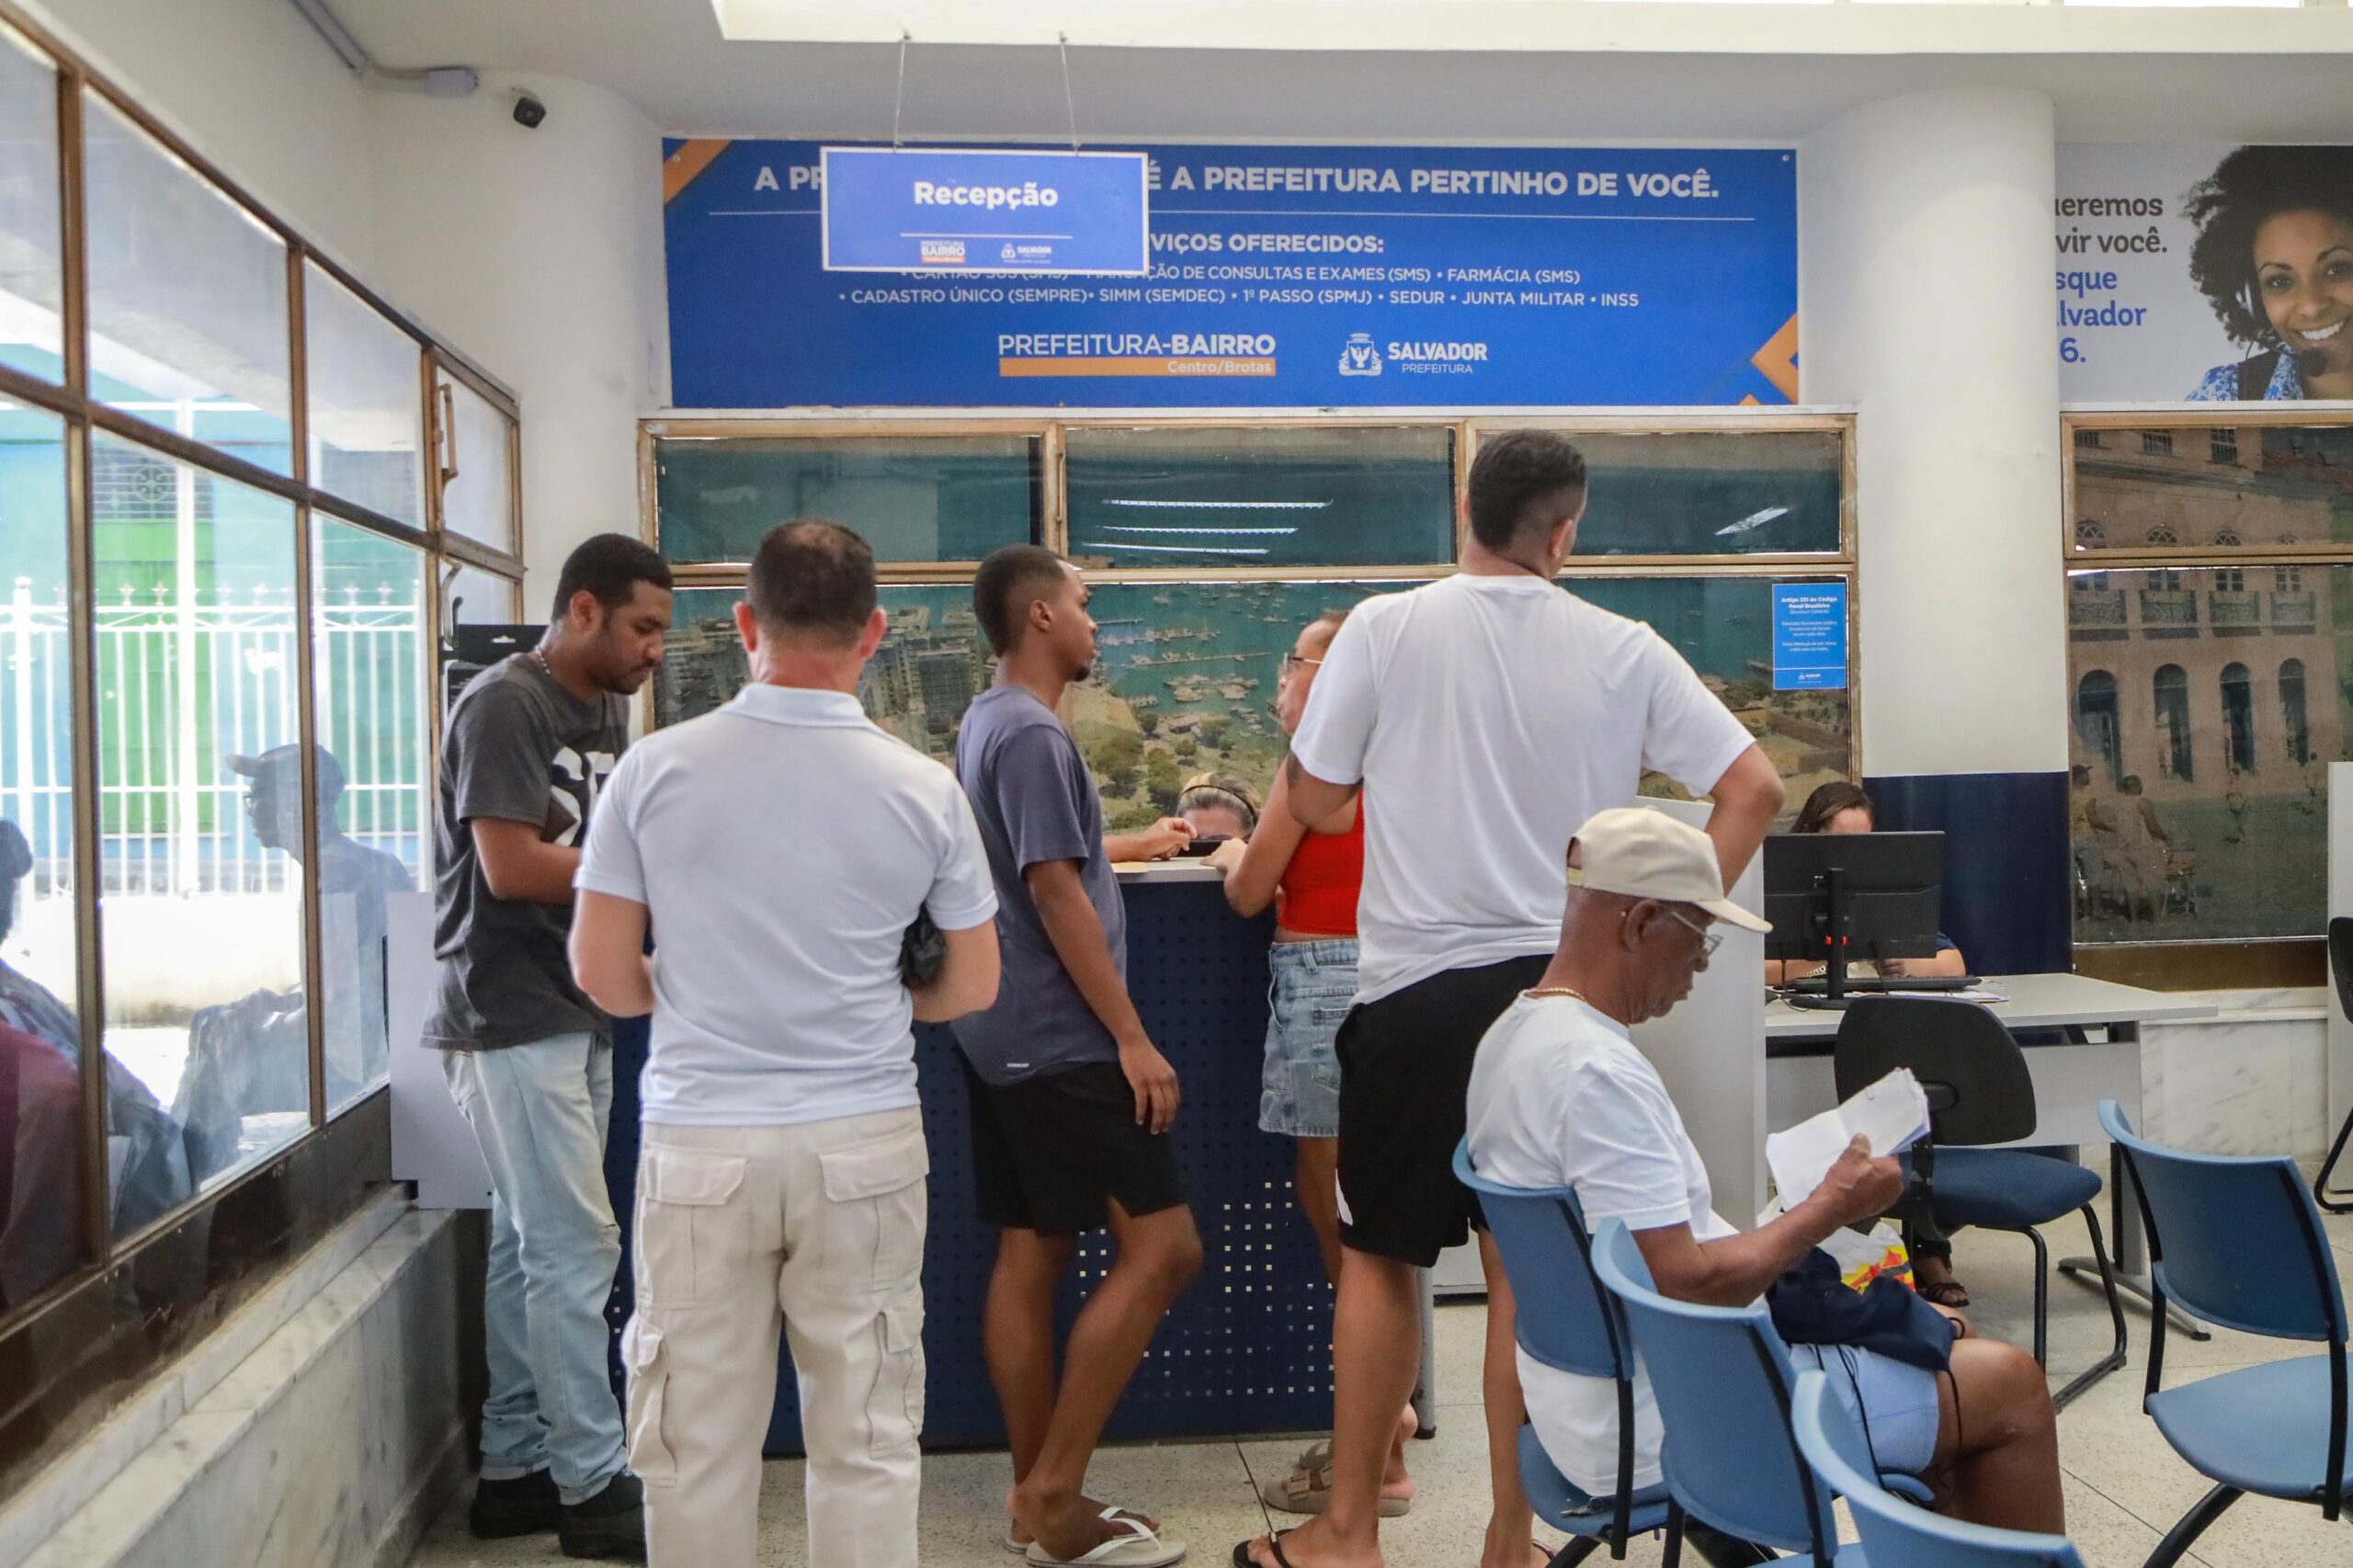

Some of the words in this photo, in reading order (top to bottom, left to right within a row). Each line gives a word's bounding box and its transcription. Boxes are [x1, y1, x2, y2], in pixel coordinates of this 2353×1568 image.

[754, 165, 780, 191] A
[1171, 165, 1195, 191] A
[1204, 166, 1402, 193] PREFEITURA
[1411, 169, 1568, 195] PERTINHO
[1577, 172, 1618, 197] DE
[1626, 168, 1720, 199] VOCÊ.
[913, 181, 1059, 210] Recepção
[921, 246, 965, 256] BAIRRO
[1149, 233, 1222, 255] VIÇOS
[1228, 233, 1384, 254] OFERECIDOS:
[2055, 226, 2092, 254] vir
[2097, 226, 2167, 254] você.
[1183, 266, 1205, 279] DE
[1208, 265, 1303, 280] CONSULTAS
[1306, 267, 1316, 280] E
[1319, 267, 1386, 281] EXAMES
[1388, 267, 1432, 283] (SMS)
[1448, 266, 1531, 282] FARMÁCIA
[1535, 269, 1581, 285] (SMS)
[2055, 270, 2118, 299] sque
[851, 290, 946, 303] CADASTRO
[950, 286, 1004, 302] ÚNICO
[1007, 288, 1087, 304] (SEMPRE)
[1099, 289, 1141, 302] SIMM
[1145, 289, 1226, 304] (SEMDEC)
[1243, 289, 1256, 302] 1º
[1259, 290, 1314, 303] PASSO
[1317, 290, 1372, 305] (SPMJ)
[1389, 290, 1445, 304] SEDUR
[1461, 290, 1516, 305] JUNTA
[1520, 291, 1585, 306] MILITAR
[1601, 293, 1639, 307] INSS
[2057, 300, 2147, 326] lvador
[998, 334, 1277, 356] PREFEITURA-BAIRRO
[1387, 342, 1488, 361] SALVADOR
[2059, 337, 2086, 363] 6.
[1166, 359, 1272, 375] Centro/Brotas
[1402, 363, 1474, 374] PREFEITURA
